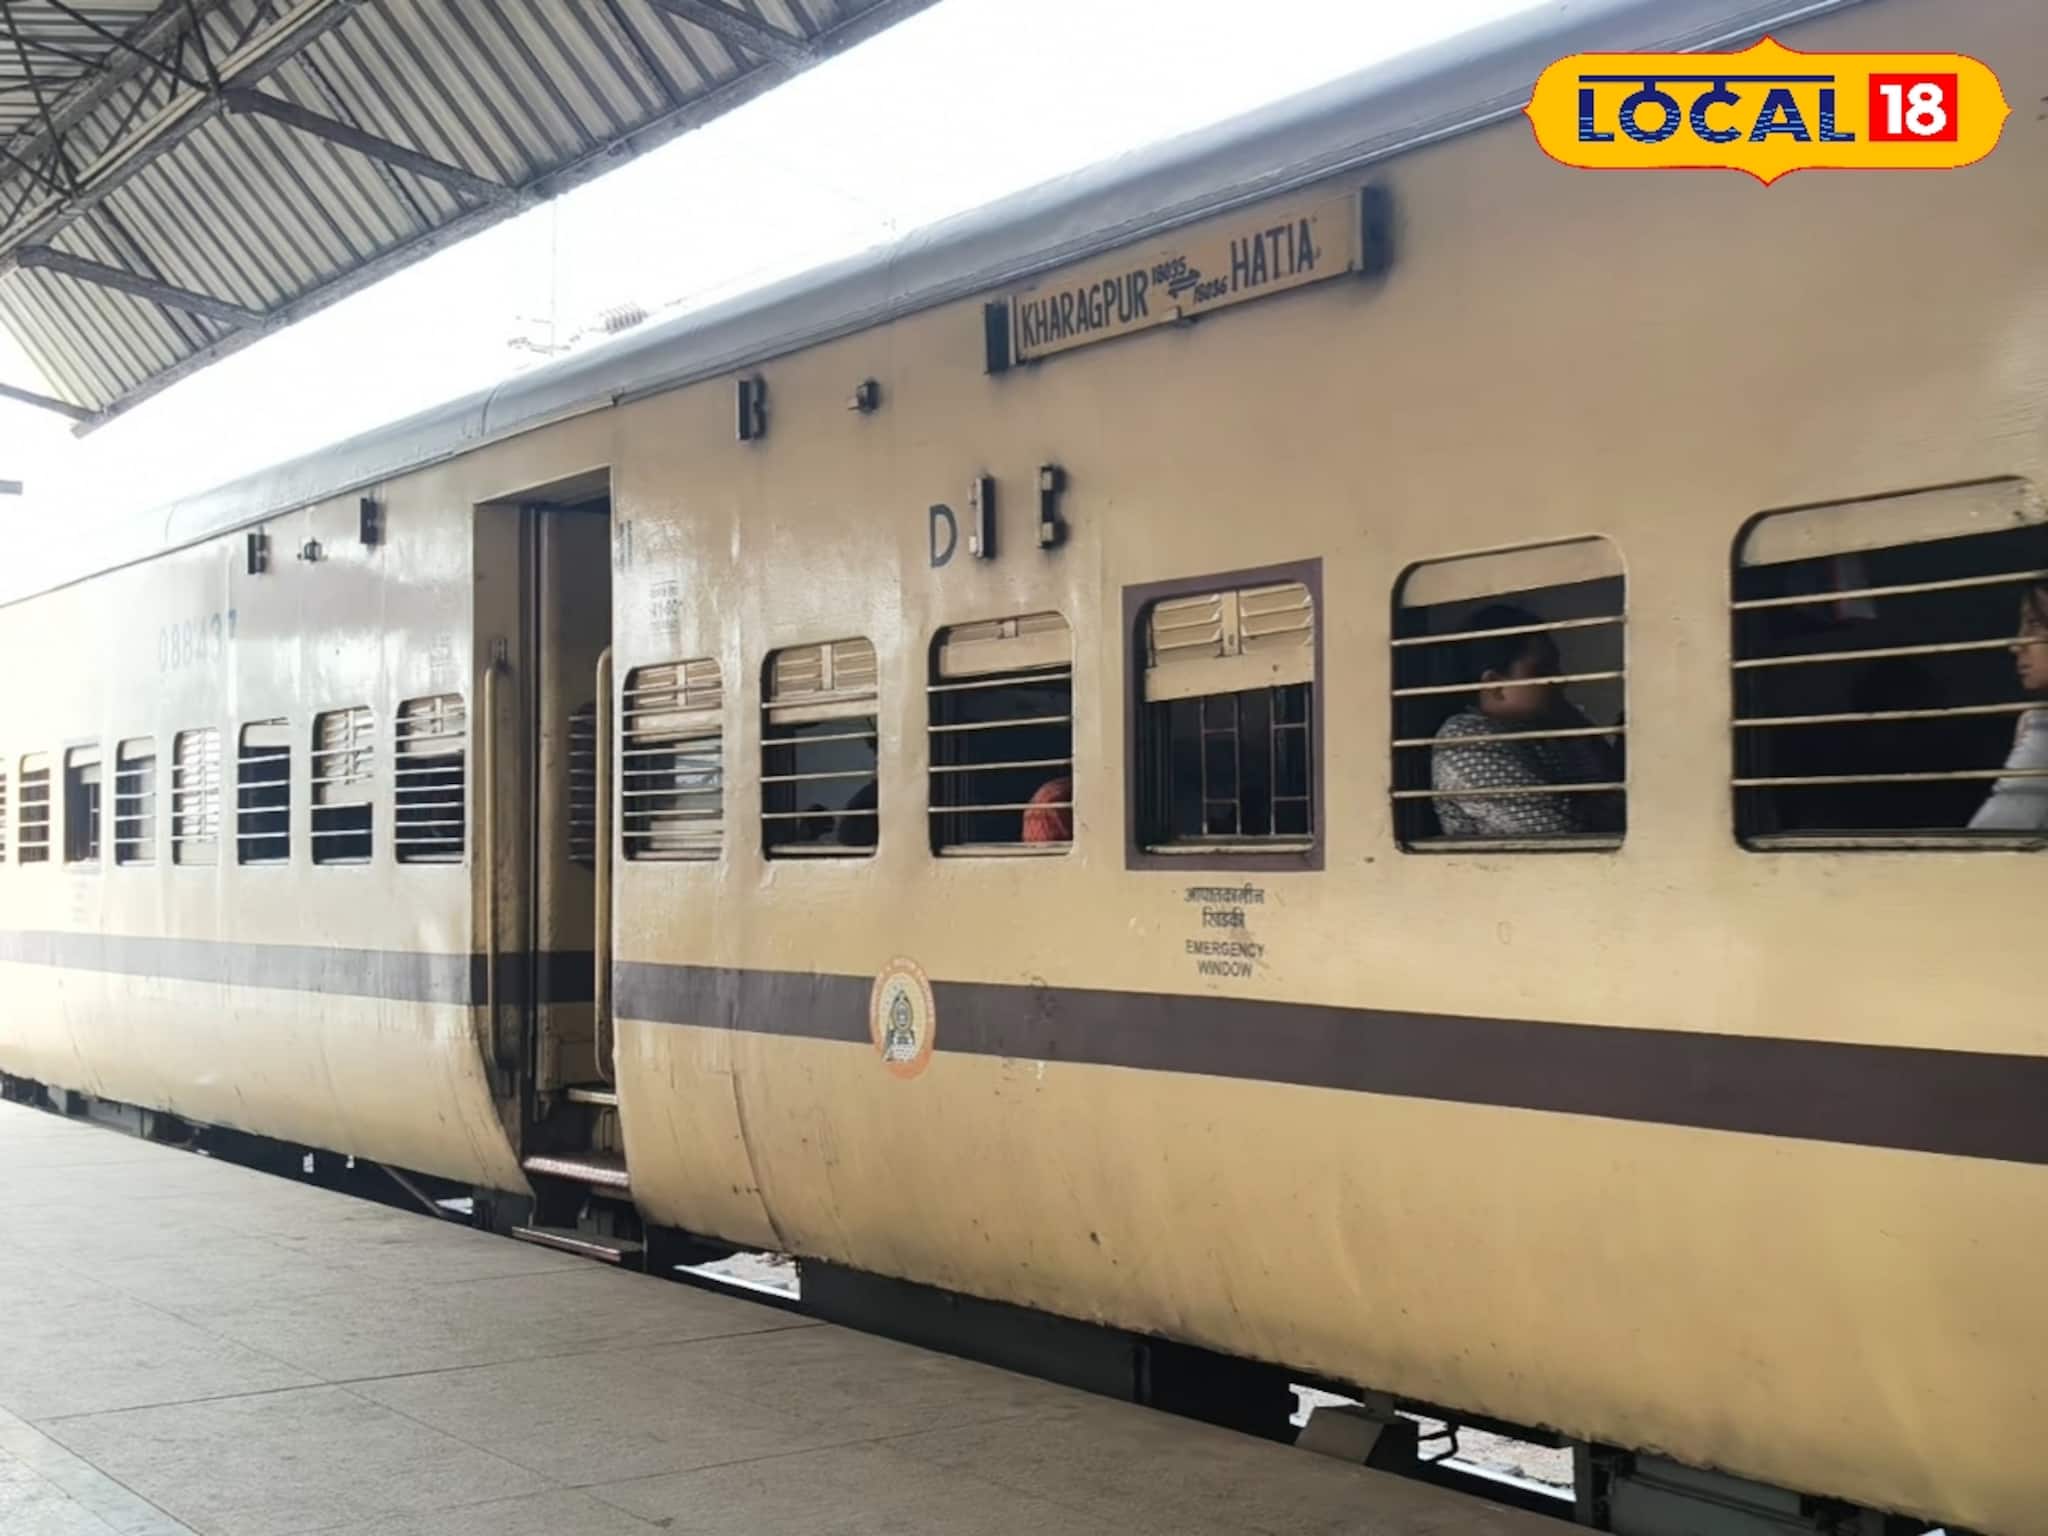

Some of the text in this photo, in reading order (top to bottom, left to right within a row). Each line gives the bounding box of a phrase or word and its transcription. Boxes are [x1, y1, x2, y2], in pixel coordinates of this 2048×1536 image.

[1022, 270, 1149, 348] KHARAGPUR
[1231, 218, 1315, 292] HATIA
[1184, 938, 1265, 958] EMERGENCY
[1197, 959, 1253, 979] WINDOW
